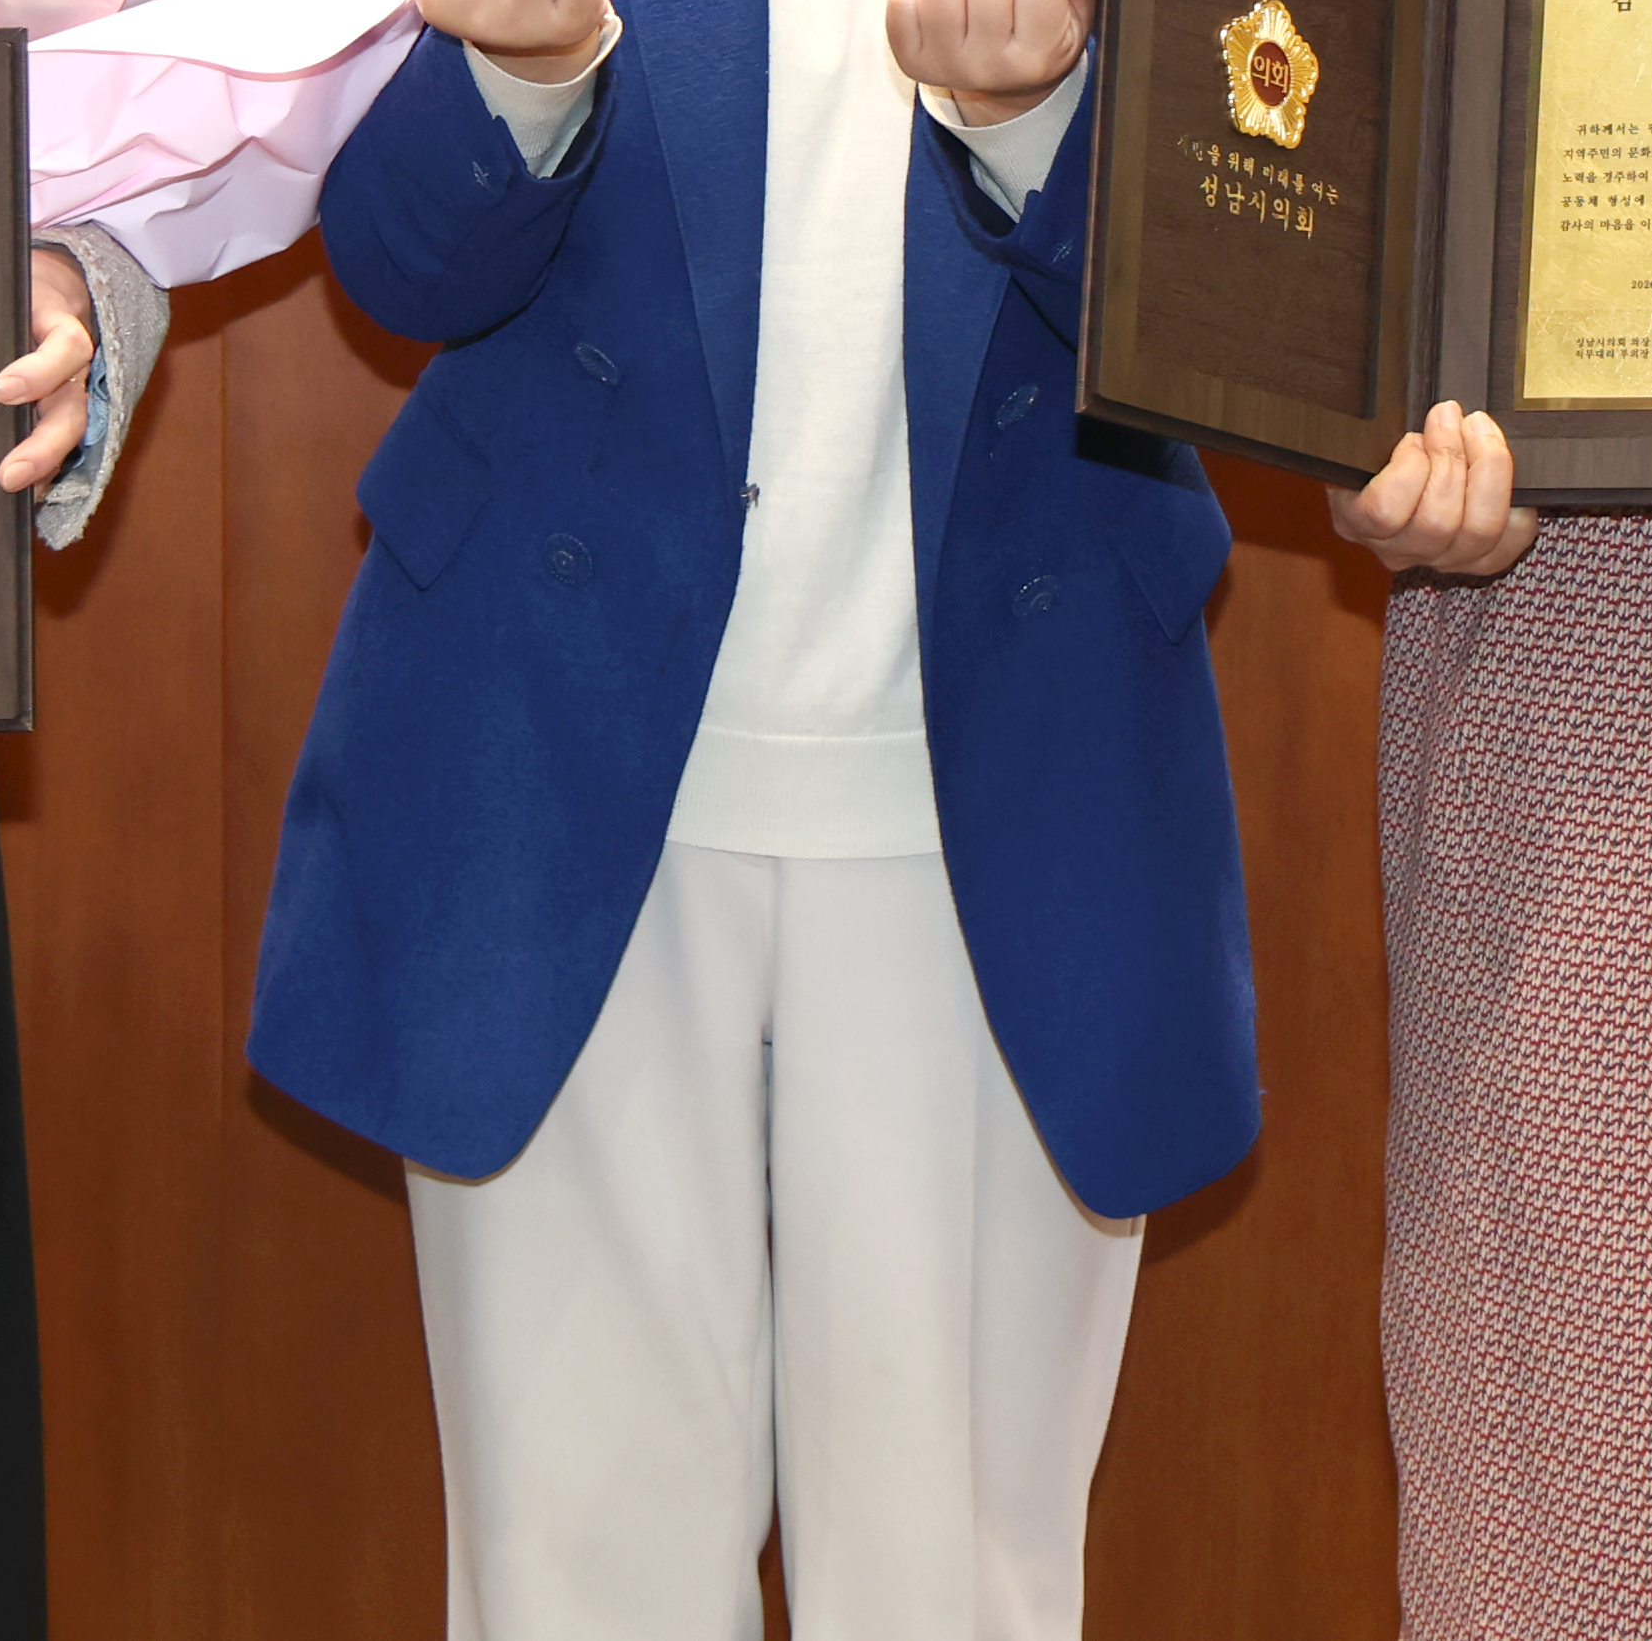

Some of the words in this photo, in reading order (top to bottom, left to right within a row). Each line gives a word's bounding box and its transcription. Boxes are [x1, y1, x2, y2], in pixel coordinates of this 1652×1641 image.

[1252, 55, 1289, 94] 의회
[1563, 146, 1622, 160] 지역주민의
[1562, 171, 1597, 184] 노력을
[1200, 173, 1314, 240] 성남시의회
[1561, 195, 1598, 208] 공동체
[1608, 194, 1645, 207] 형성에
[1560, 219, 1594, 232] 감사의
[1600, 218, 1634, 231] 마음을
[1640, 218, 1651, 230] 이
